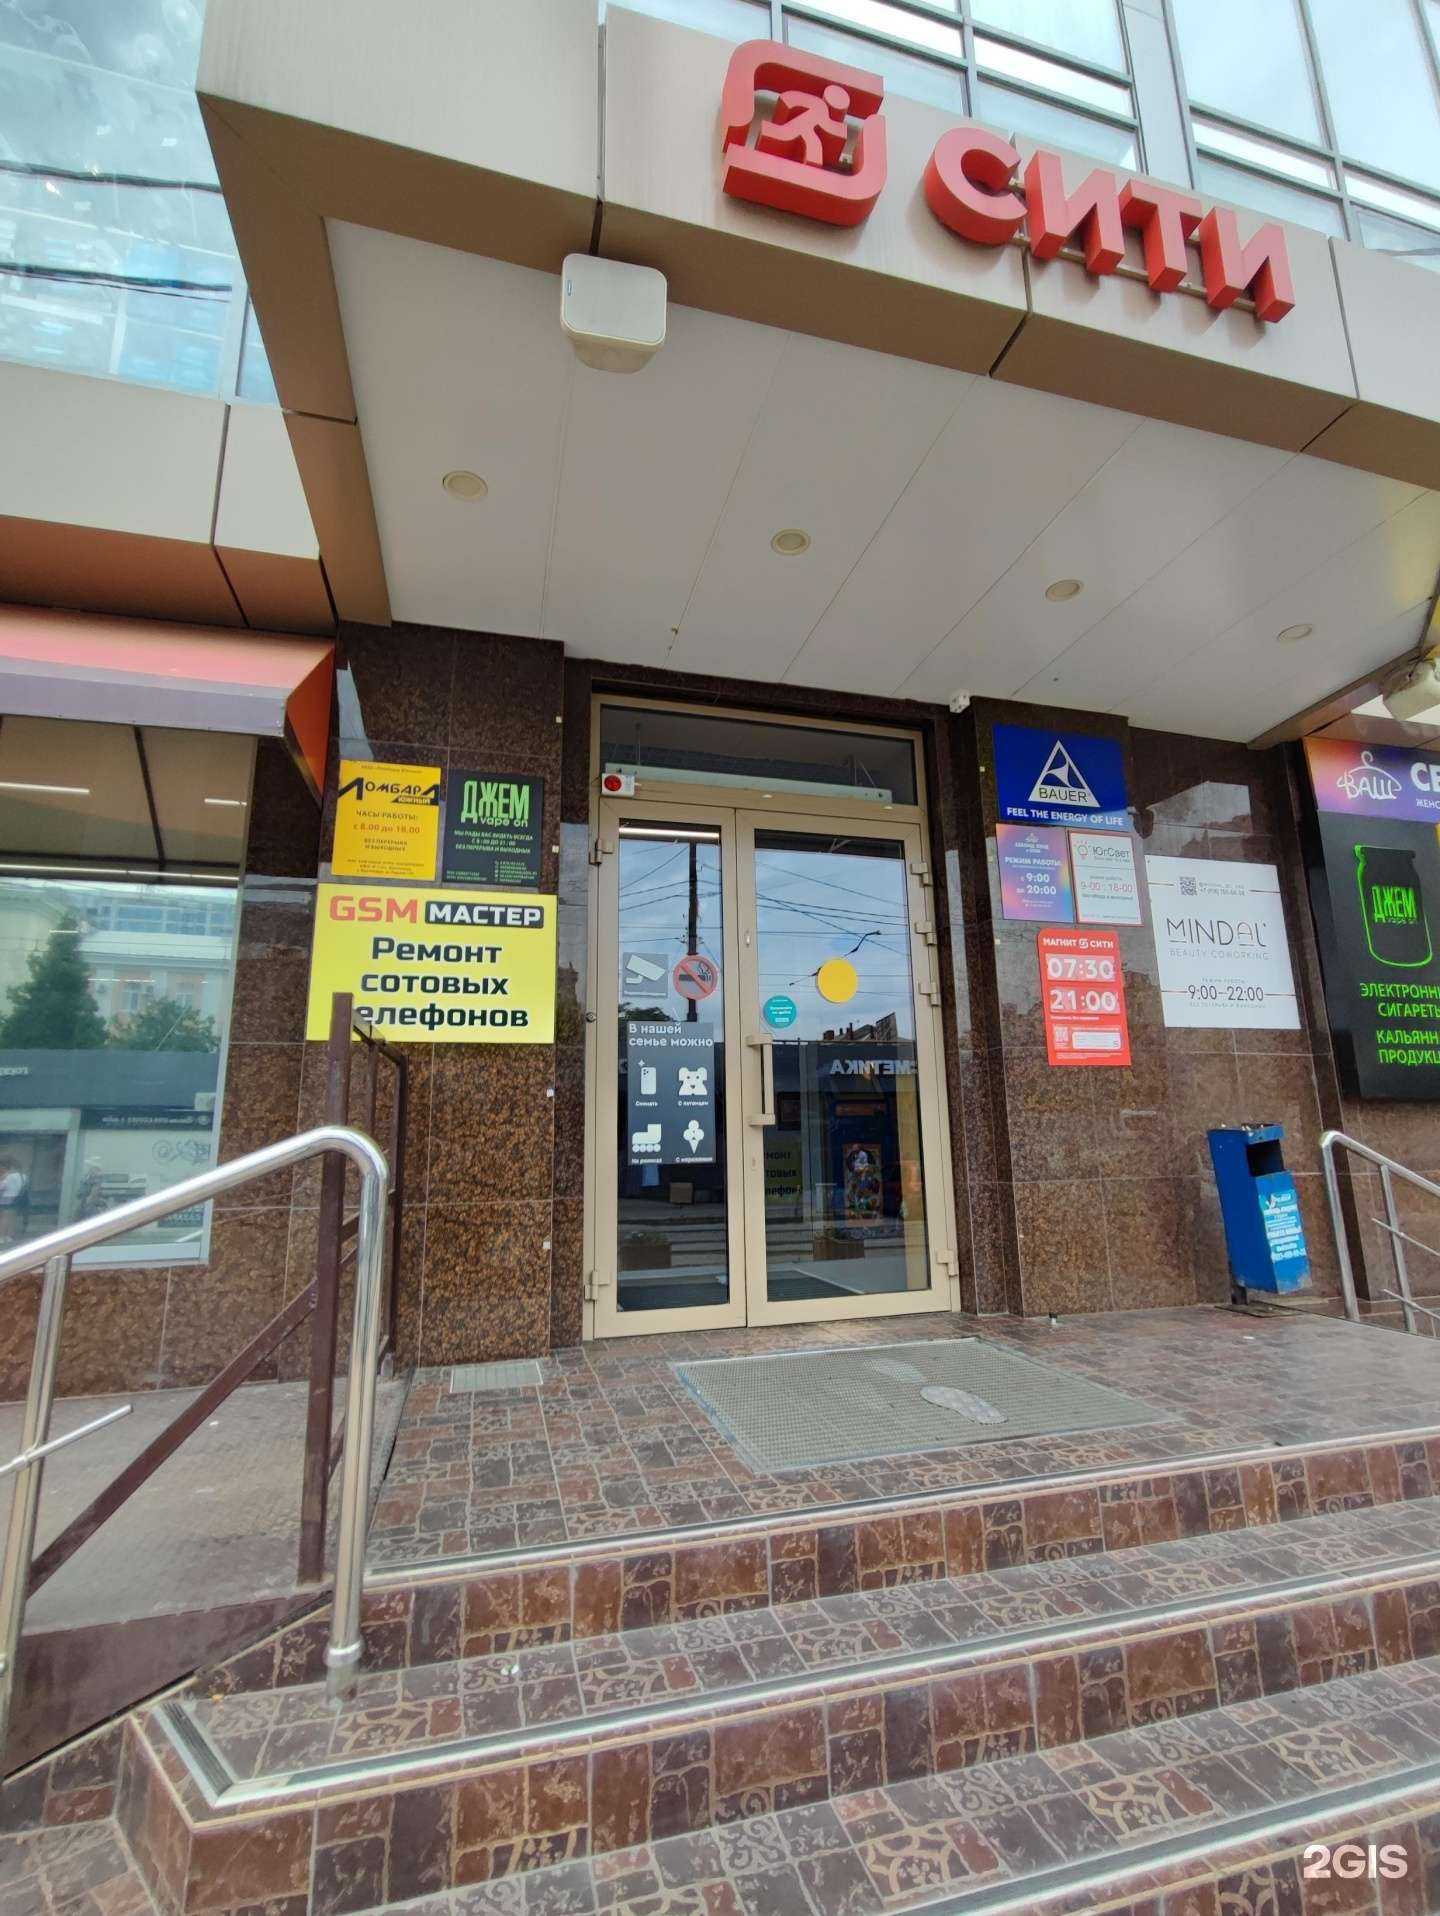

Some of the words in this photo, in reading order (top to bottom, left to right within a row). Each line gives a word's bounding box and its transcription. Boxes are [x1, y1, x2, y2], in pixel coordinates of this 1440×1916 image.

[923, 127, 1296, 324] СИТИ
[337, 777, 440, 803] ЛОМБАРД
[1039, 787, 1088, 803] BAUER
[460, 781, 530, 824] ДЖЕМ
[356, 809, 380, 818] ЧАСЫ
[480, 817, 510, 827] vape
[513, 819, 528, 828] on
[1006, 807, 1029, 818] FEEL
[1030, 809, 1049, 819] THE
[1051, 811, 1088, 822] ENERGY
[1090, 814, 1104, 824] OF
[1105, 816, 1124, 826] LIFE
[1026, 872, 1050, 883] 9:00
[1027, 884, 1057, 896] 20:00
[329, 895, 418, 924] GSM
[428, 903, 542, 927] МАСТЕР
[1371, 885, 1417, 923] ДЖЕМ
[371, 936, 503, 964] Ремонт
[1042, 937, 1077, 948] МАГНИТ
[1090, 940, 1114, 949] СИТИ
[1169, 949, 1206, 959] BEAUTY
[1047, 957, 1115, 980] 07:30
[361, 973, 509, 996] сотовых
[1049, 988, 1117, 1012] 21:00
[356, 1003, 529, 1031] елефонов
[629, 1023, 637, 1034] В
[640, 1022, 682, 1034] нашей
[628, 1037, 668, 1047] семье
[670, 1037, 714, 1047] можно
